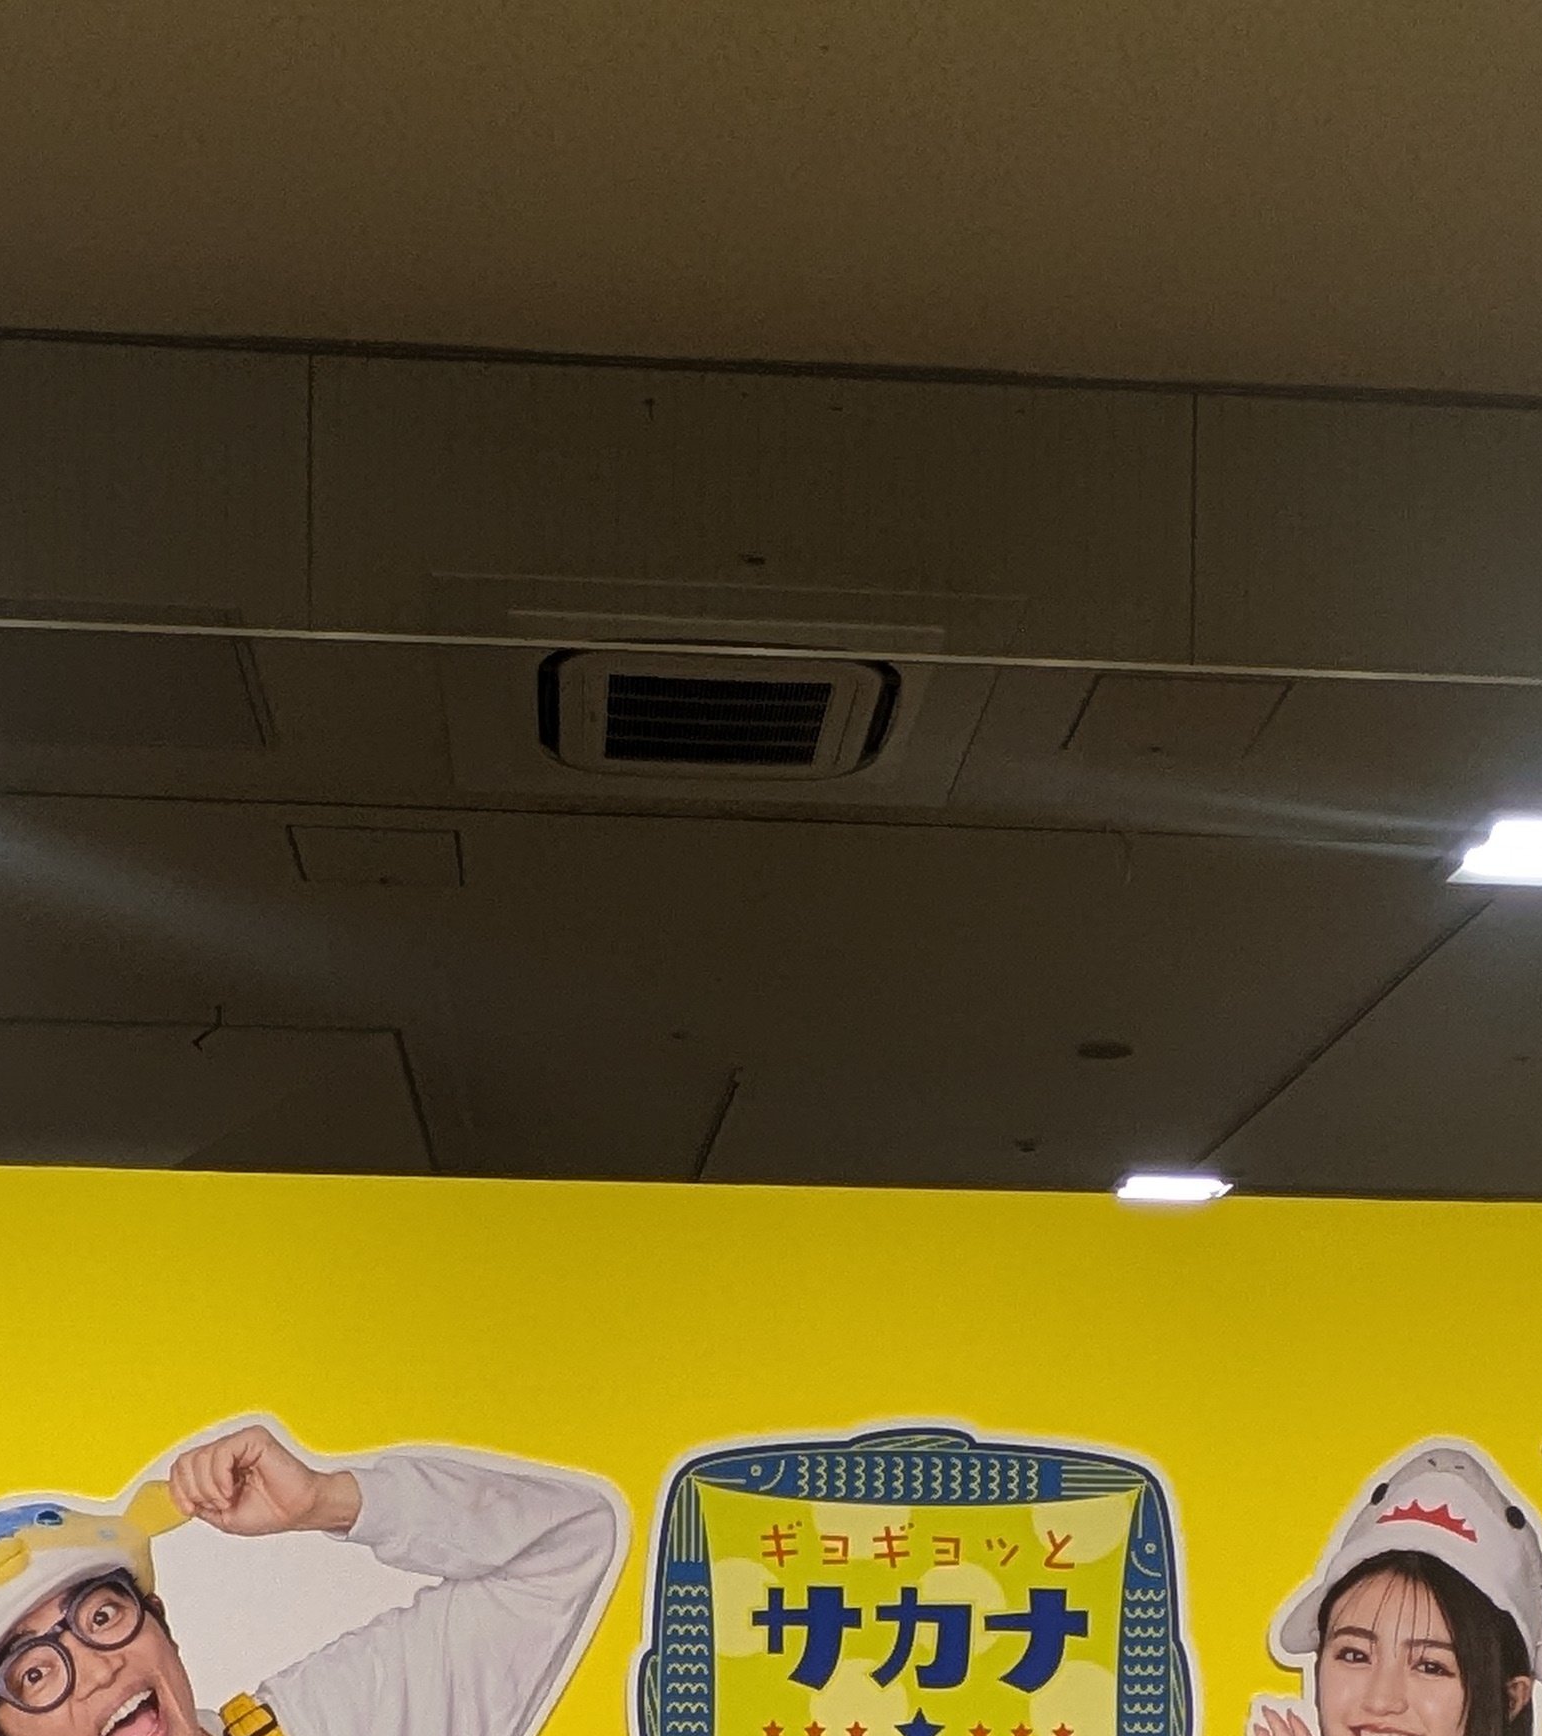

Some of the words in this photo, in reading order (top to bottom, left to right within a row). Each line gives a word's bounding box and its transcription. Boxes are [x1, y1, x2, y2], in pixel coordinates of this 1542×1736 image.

[760, 1520, 1076, 1570] ギョギョッと
[751, 1584, 1090, 1694] サカナ
